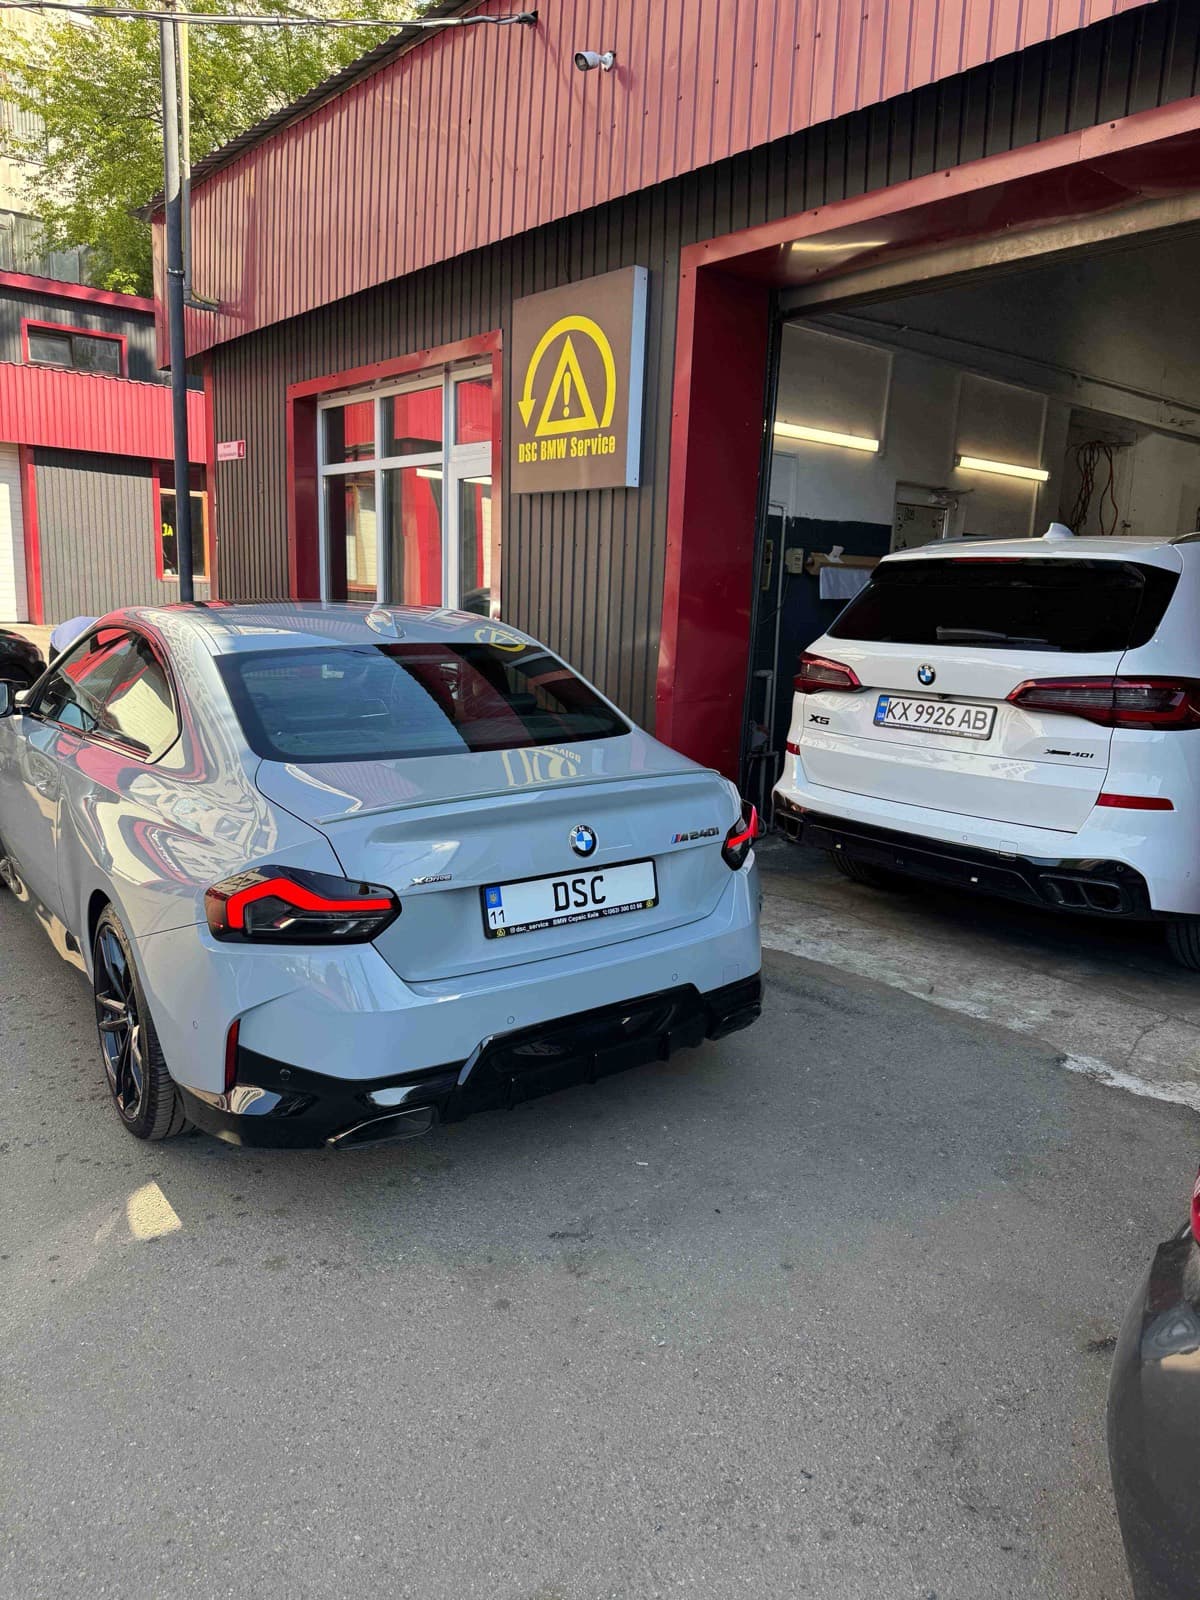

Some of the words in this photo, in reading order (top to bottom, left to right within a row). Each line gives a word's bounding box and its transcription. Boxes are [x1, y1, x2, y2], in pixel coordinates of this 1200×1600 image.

[518, 442, 538, 463] DSC
[540, 438, 567, 461] BMW
[570, 433, 616, 457] Service
[809, 714, 830, 725] X5
[914, 704, 956, 726] 9926
[958, 709, 988, 730] AB
[552, 875, 606, 911] DSC
[490, 909, 505, 924] 11
